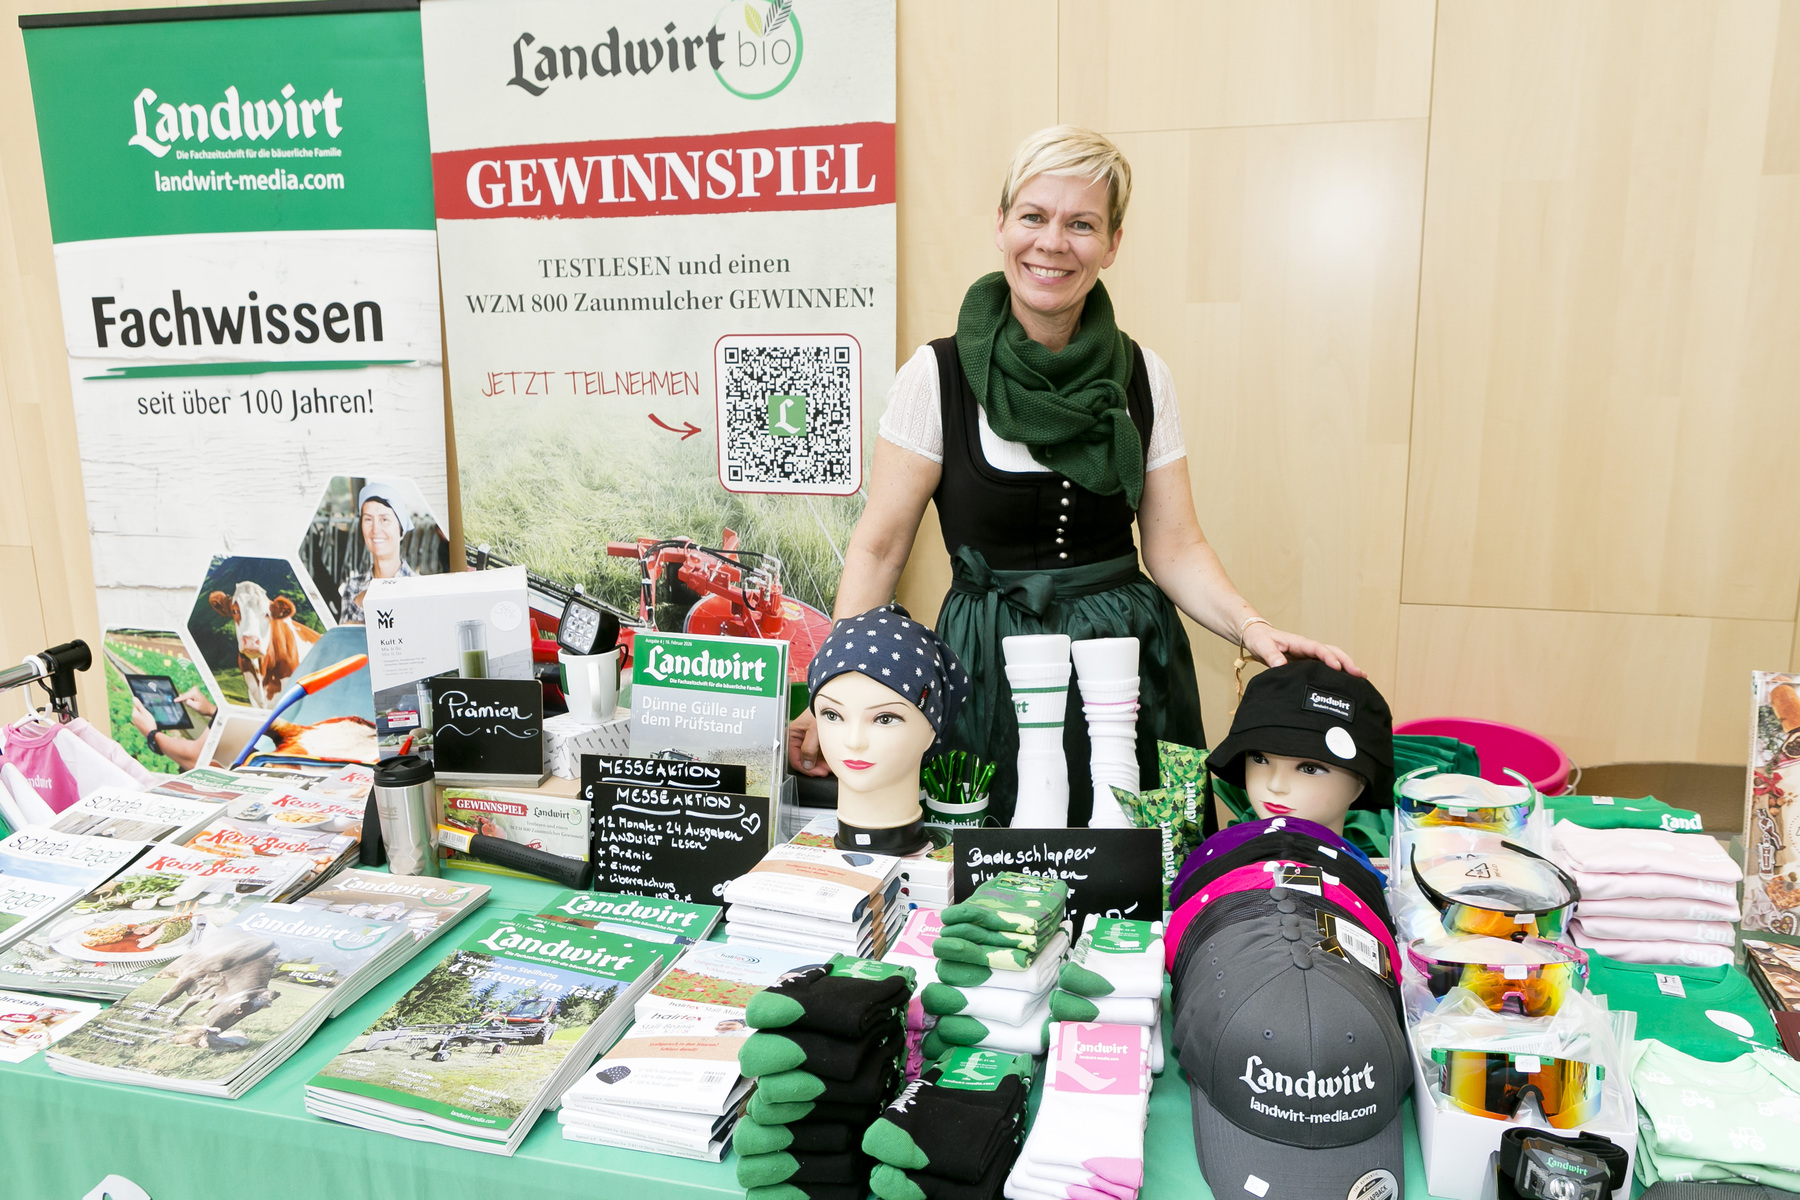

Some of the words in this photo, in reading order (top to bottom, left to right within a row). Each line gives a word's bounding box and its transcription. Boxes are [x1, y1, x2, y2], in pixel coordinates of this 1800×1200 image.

[506, 22, 725, 96] Landwirt
[738, 31, 791, 67] bio
[128, 83, 343, 158] Landwirt
[176, 150, 187, 160] Die
[189, 149, 244, 160] Fachzeitschrift
[246, 148, 257, 159] für
[259, 148, 270, 158] die
[271, 147, 313, 158] bäuerliche
[314, 147, 342, 157] Familie
[155, 169, 345, 192] landwirt-media.com
[465, 143, 877, 209] GEWINNSPIEL
[538, 255, 671, 279] TESTLESEN
[678, 254, 721, 276] und
[728, 255, 791, 274] einen
[466, 293, 526, 314] WZM
[531, 293, 568, 312] 800
[574, 289, 723, 312] Zaunmulcher
[729, 287, 874, 309] GEWINNEN!
[91, 289, 384, 348] Fachwissen
[481, 371, 555, 397] JETZT
[565, 370, 699, 396] TEILNEHMEN
[137, 392, 176, 414] seit
[183, 390, 231, 414] über
[240, 390, 283, 414] 100
[290, 388, 374, 421] Jahren!
[643, 645, 767, 682] Landwirt
[439, 690, 533, 721] Prämien
[642, 696, 687, 713] Dünne
[691, 701, 728, 717] Gülle
[733, 706, 756, 720] auf
[1309, 692, 1350, 711] Landwirt
[641, 711, 670, 727] dem
[675, 715, 743, 734] Prüfstand
[28, 774, 52, 789] ndwirt
[456, 799, 525, 815] GEWINNSPIEL
[533, 806, 570, 820] Landwirt
[1184, 780, 1196, 823] dwirt
[599, 816, 615, 828] 12
[666, 822, 682, 835] 24
[1660, 814, 1702, 831] Land
[207, 829, 257, 845] Koch
[252, 837, 310, 852] Back
[609, 845, 652, 860] Prämie
[1162, 821, 1175, 885] Landwirt
[146, 856, 202, 871] Koch
[198, 858, 261, 877] Back
[610, 861, 641, 873] Eimer
[971, 870, 994, 885] plu
[333, 876, 434, 900] Landwirt
[434, 889, 460, 901] bio
[556, 895, 700, 928] Landwirt
[237, 912, 350, 941] Landwirt
[348, 929, 375, 944] bio
[477, 926, 635, 970] Landwirt
[460, 955, 502, 969] Schwaden
[503, 964, 517, 972] am
[517, 967, 559, 980] Steilhang
[514, 952, 551, 964] Fachzeitschrift
[569, 962, 596, 973] bäuerliche
[597, 968, 616, 976] Familie
[303, 972, 335, 982] Fokus
[448, 963, 459, 973] 4
[462, 965, 537, 988] Systeme
[538, 979, 563, 992] im
[567, 984, 606, 1001] Test
[0, 995, 45, 1008] hresabo
[1073, 1040, 1128, 1054] Landwirt
[1239, 1055, 1375, 1100] Landwirt
[450, 1110, 496, 1125] landwirt-media.com
[1250, 1096, 1377, 1124] landwirt-media.com
[1546, 1157, 1588, 1176] Landwirt
